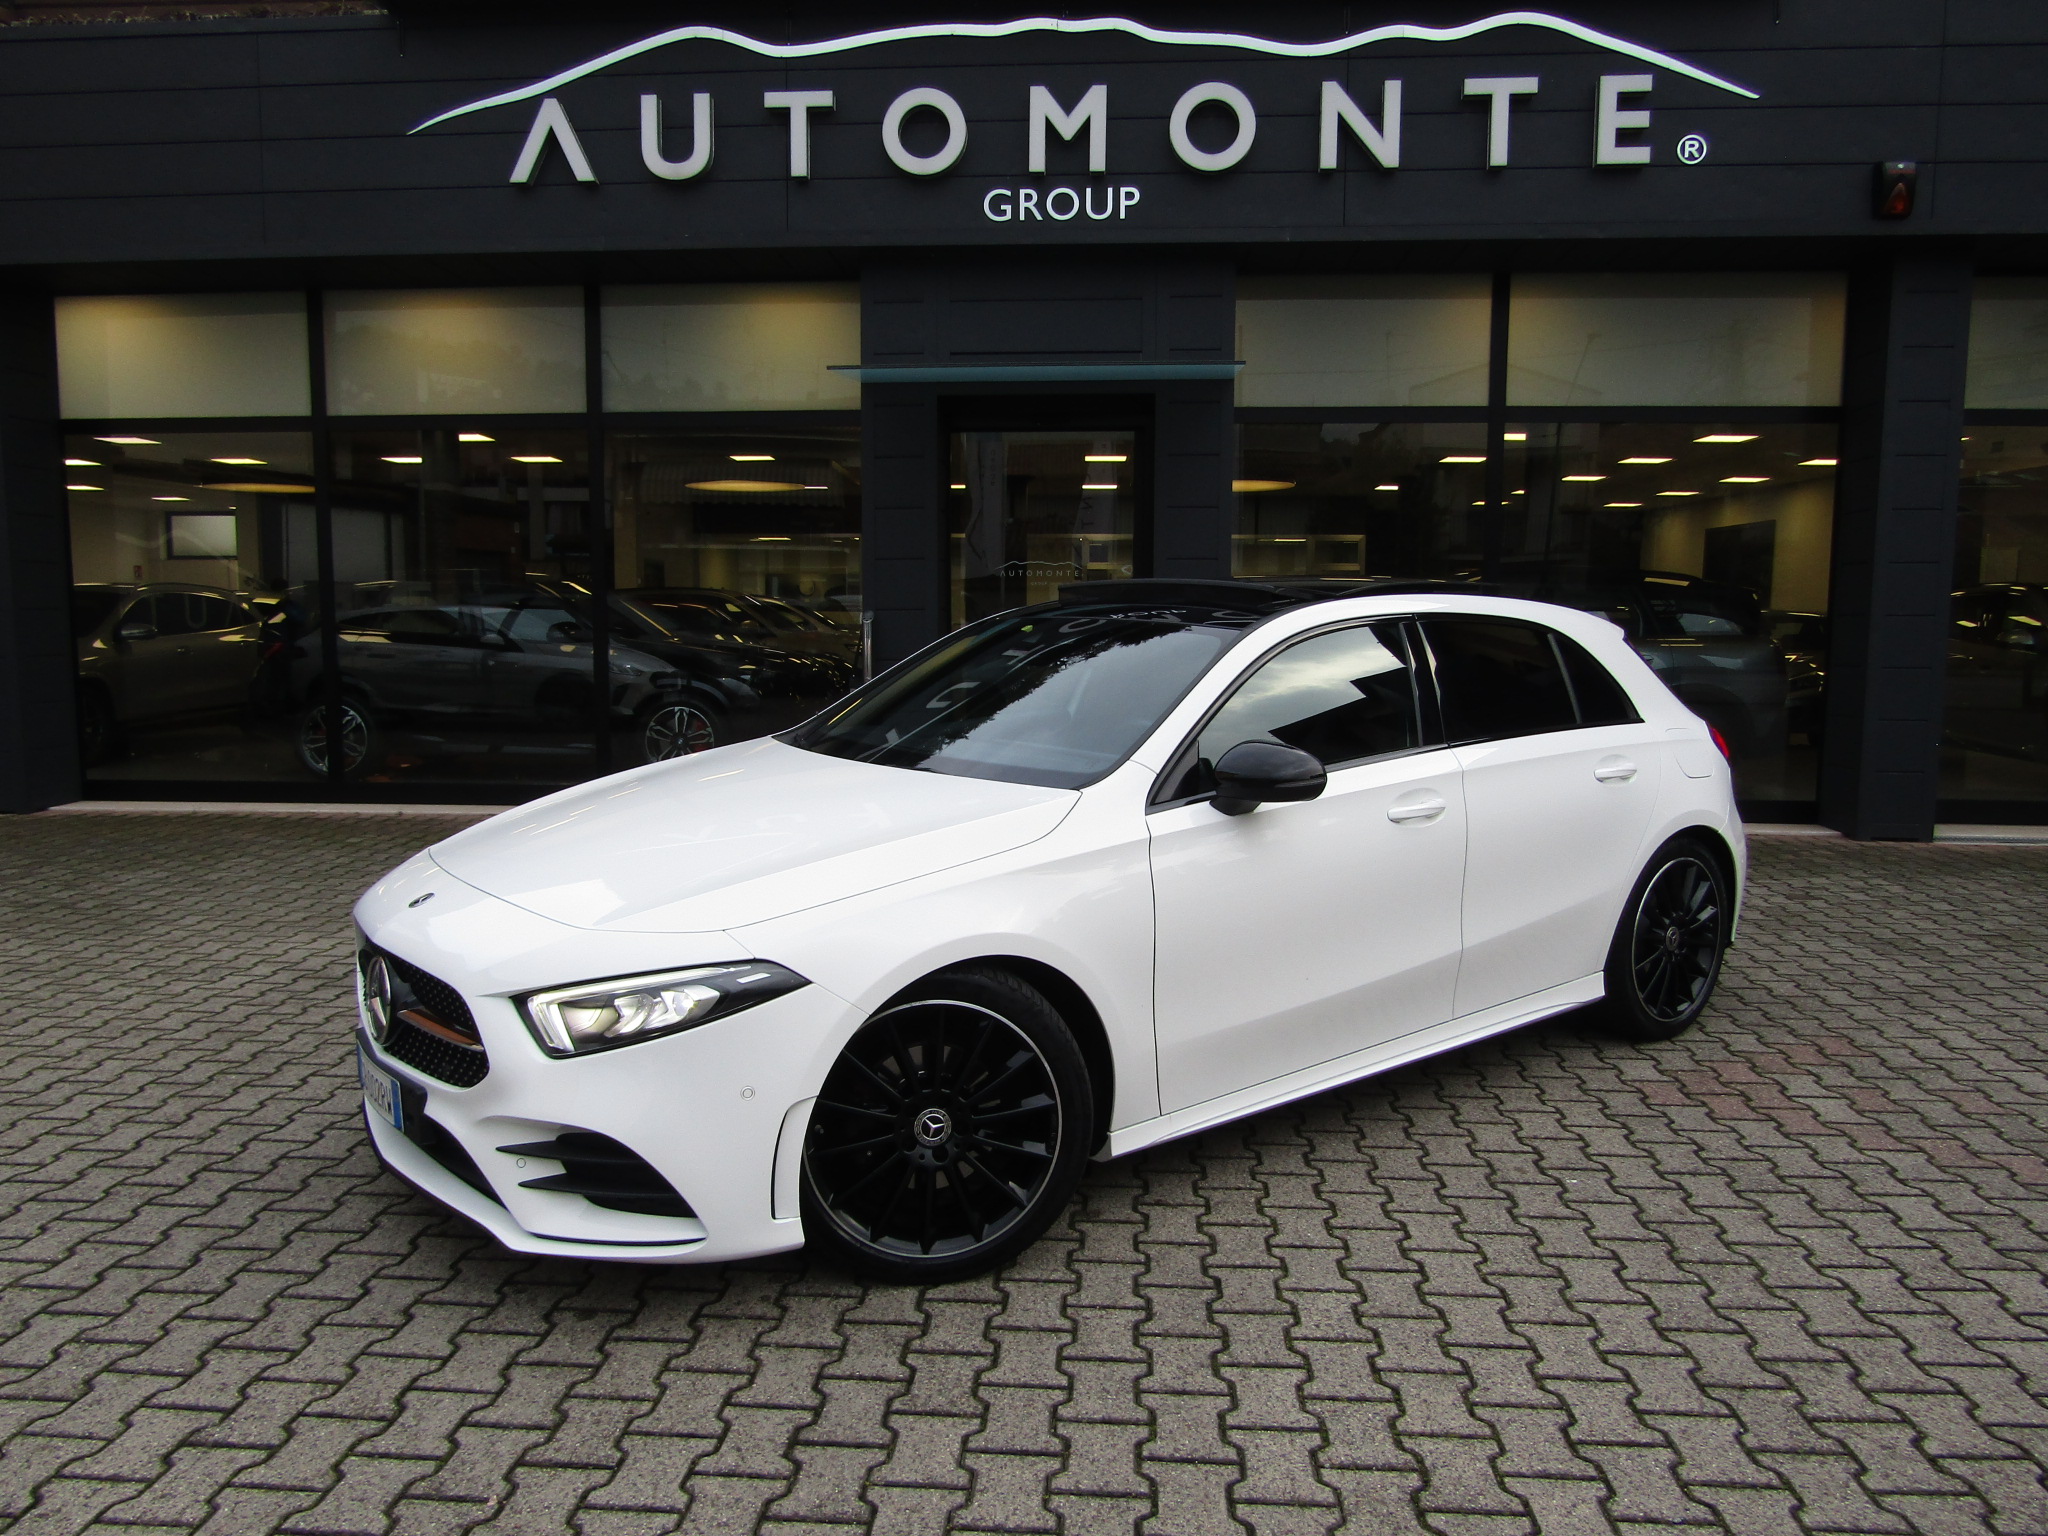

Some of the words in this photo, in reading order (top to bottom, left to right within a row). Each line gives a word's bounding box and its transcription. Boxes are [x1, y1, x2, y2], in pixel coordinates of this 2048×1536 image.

[508, 74, 1653, 184] AUTOMONTE
[983, 186, 1141, 222] GROUP
[1000, 569, 1080, 578] AUTOMONTE
